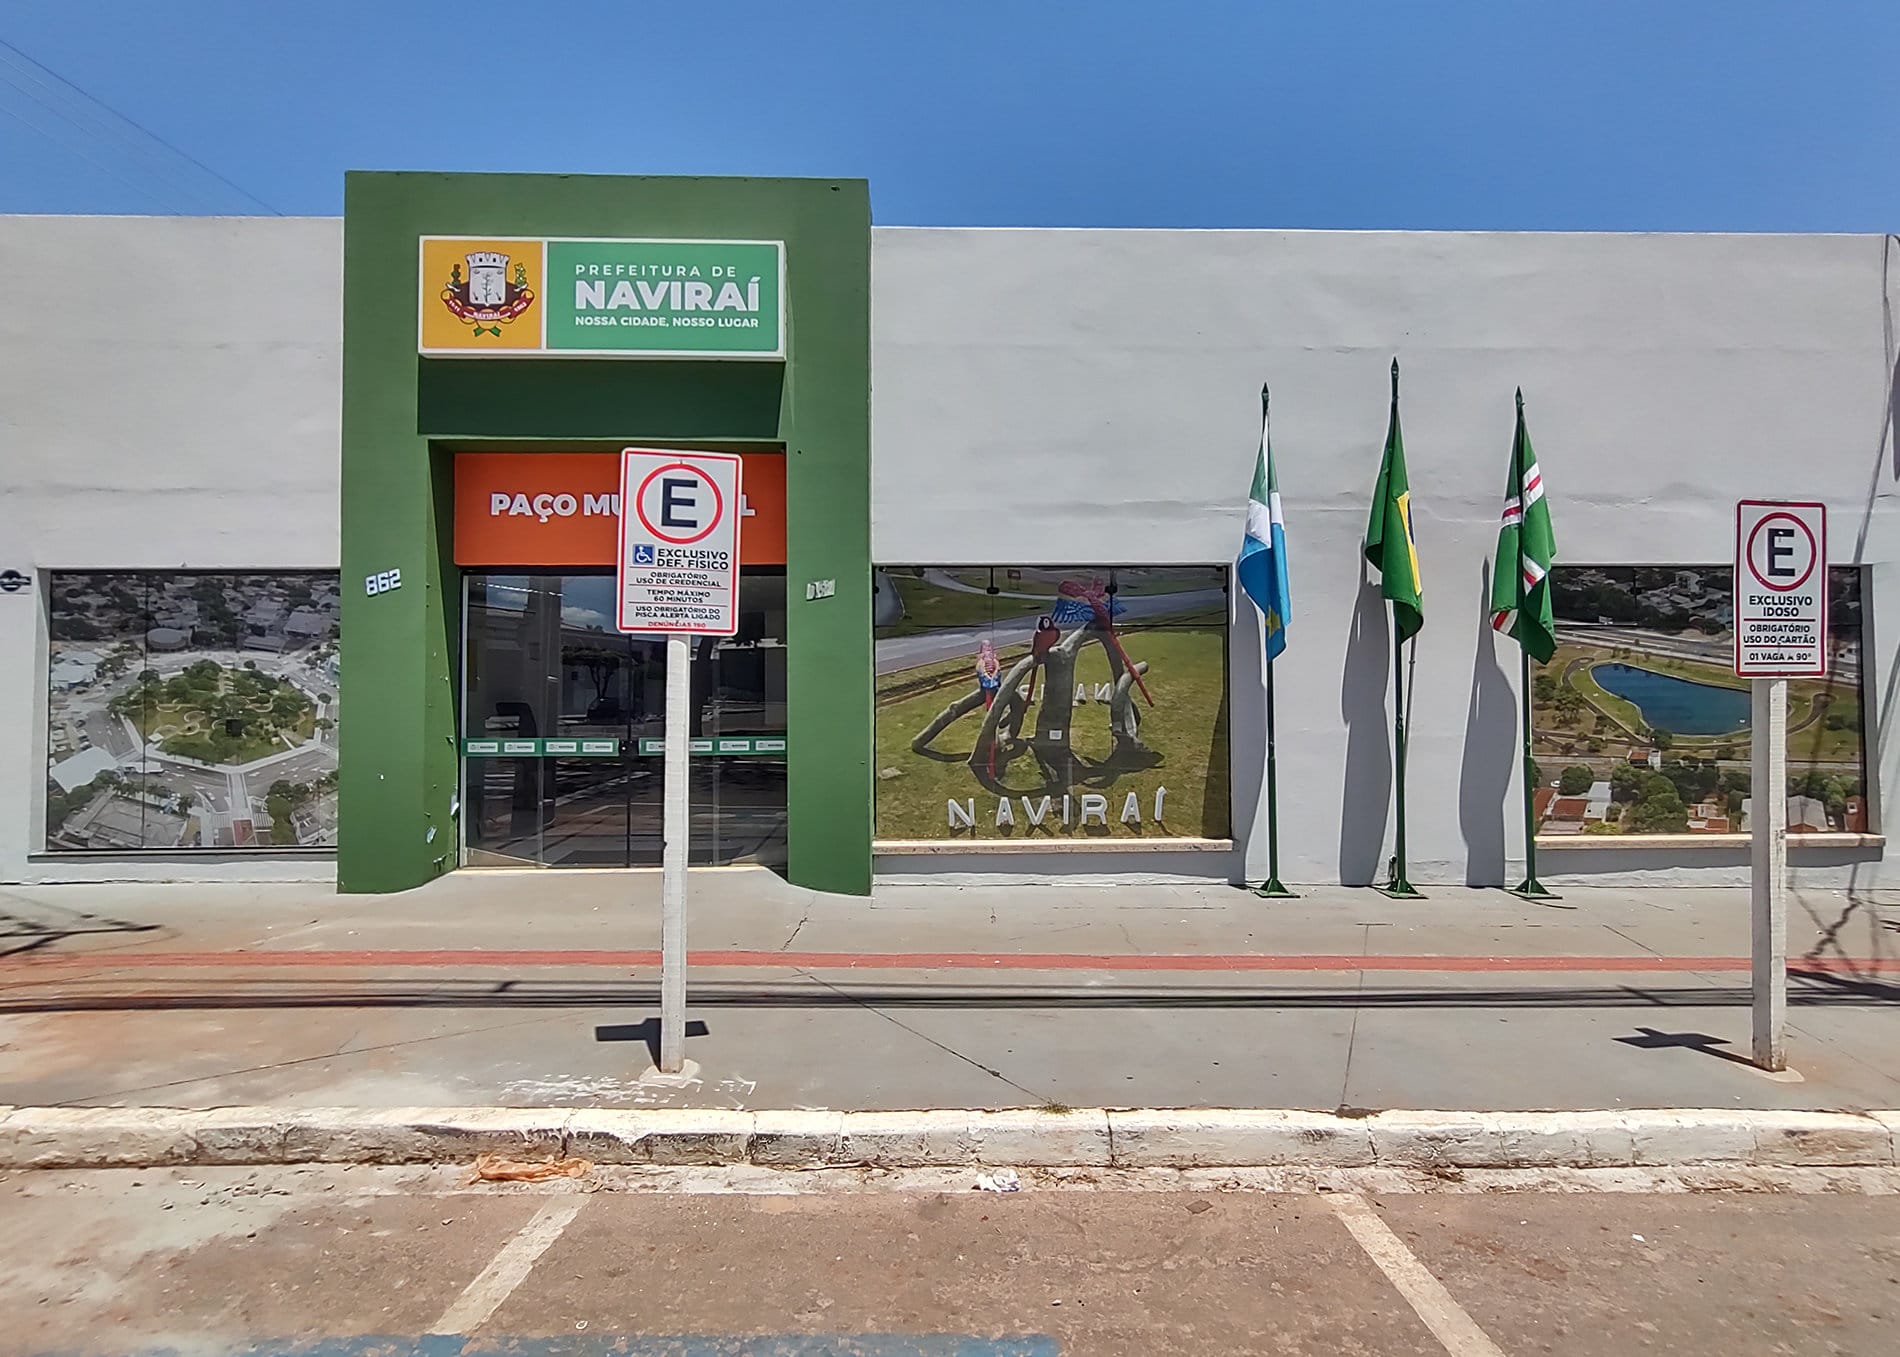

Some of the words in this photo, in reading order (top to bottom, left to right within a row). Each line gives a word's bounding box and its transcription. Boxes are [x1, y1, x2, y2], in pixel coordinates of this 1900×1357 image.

[575, 264, 701, 277] PREFEITURA
[711, 266, 736, 278] DE
[575, 276, 761, 312] NAVIRAÍ
[575, 316, 618, 326] NOSSA
[620, 317, 670, 328] CIDADE,
[672, 318, 715, 327] NOSSO
[718, 318, 759, 328] LUGAR
[490, 493, 577, 522] PAÇO
[661, 478, 698, 528] E
[658, 548, 728, 560] EXCLUSIVO
[1768, 528, 1795, 576] E
[657, 558, 684, 568] DEF.
[688, 558, 729, 570] FÍSICO
[366, 568, 402, 596] 862
[650, 572, 708, 580] OBRIGATÓRIO
[669, 578, 721, 587] CREDENCIAL
[677, 589, 710, 598] MÁXIMO
[1749, 596, 1812, 606] EXCLUSIVO
[654, 605, 706, 614] OBRIGATÓRIO
[1763, 607, 1800, 617] IDOSO
[1750, 622, 1810, 632] OBRIGATÓRIO
[1744, 636, 1762, 644] USO
[1764, 636, 1776, 644] DO
[1778, 634, 1816, 644] CARTÃO
[948, 786, 1168, 827] NAVIRAÍ
